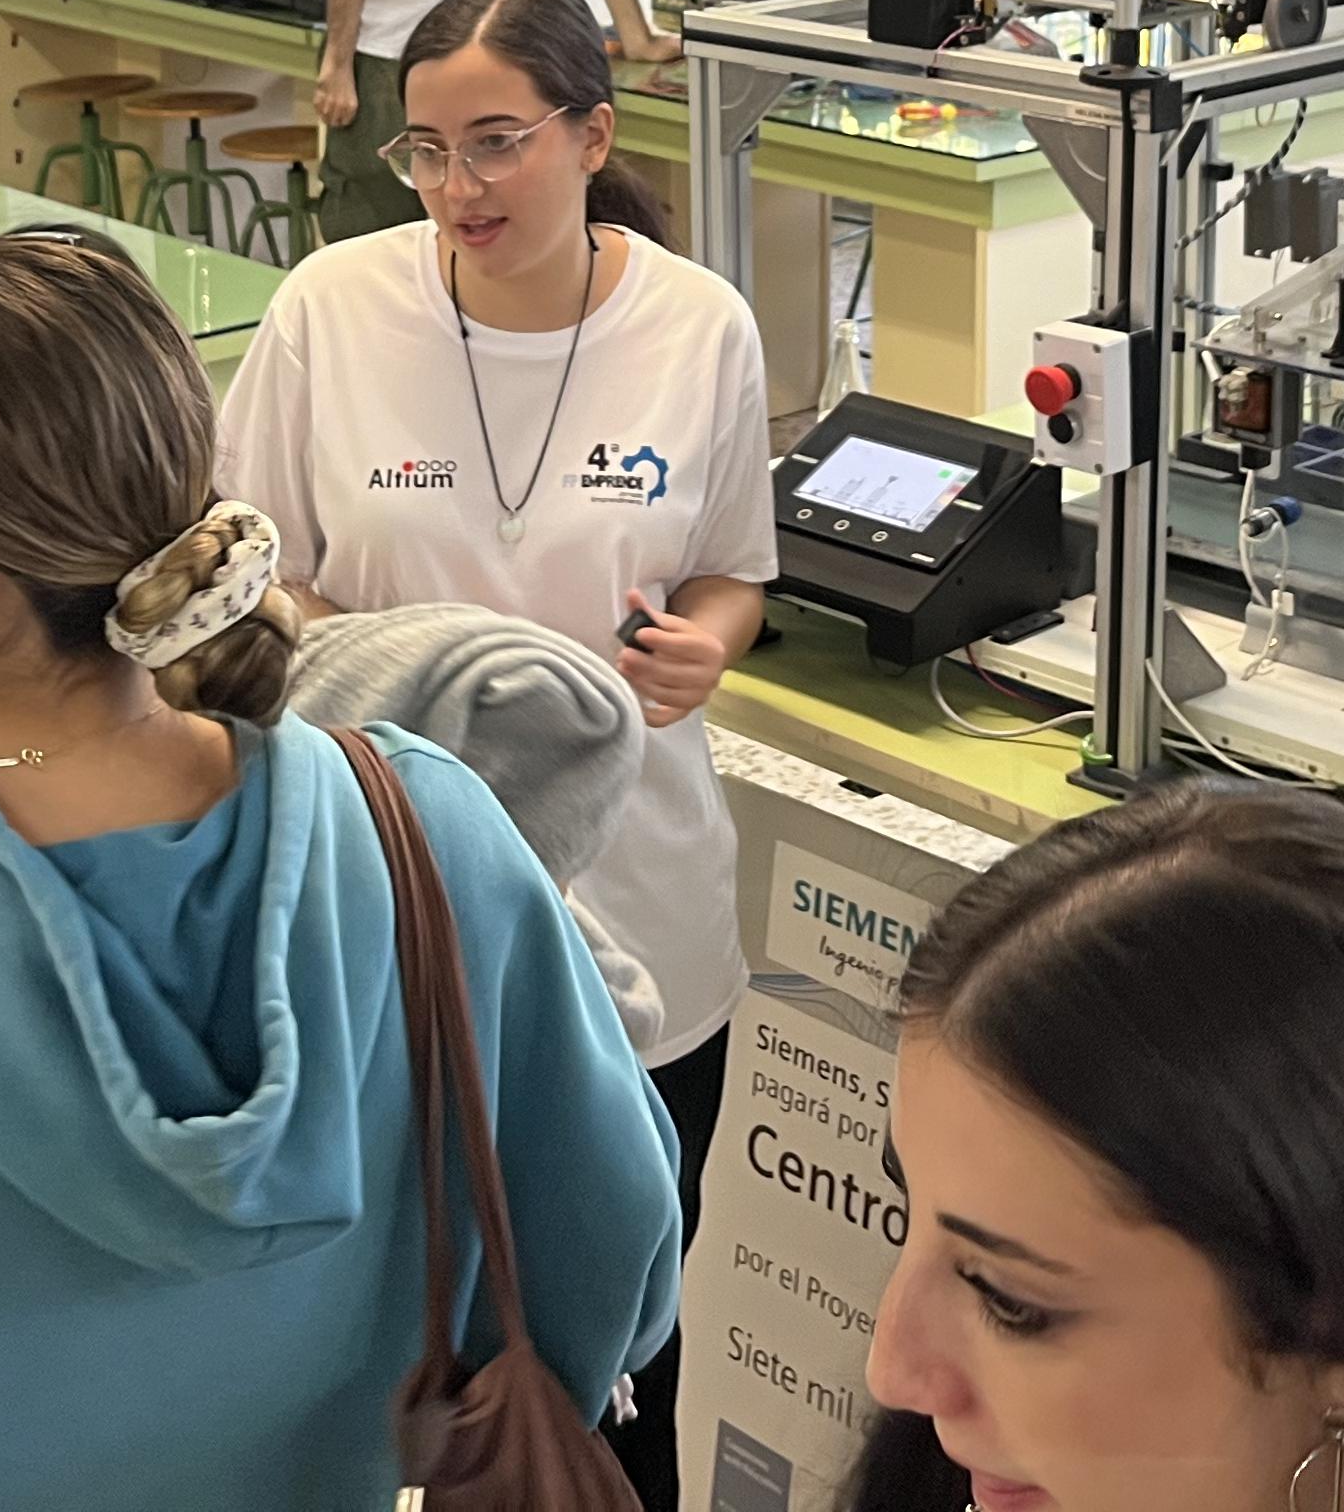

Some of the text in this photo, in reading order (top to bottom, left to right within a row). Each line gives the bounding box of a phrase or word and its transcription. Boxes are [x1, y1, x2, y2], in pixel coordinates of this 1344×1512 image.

[367, 464, 453, 489] Altium
[819, 935, 883, 977] Ingenio
[756, 1023, 867, 1102] Siemens,
[751, 1070, 879, 1147] pagará por
[747, 1124, 909, 1247] Centro
[734, 1243, 775, 1278] por
[778, 1267, 801, 1295] el
[727, 1326, 799, 1395] Siete
[806, 1380, 854, 1429] mil
